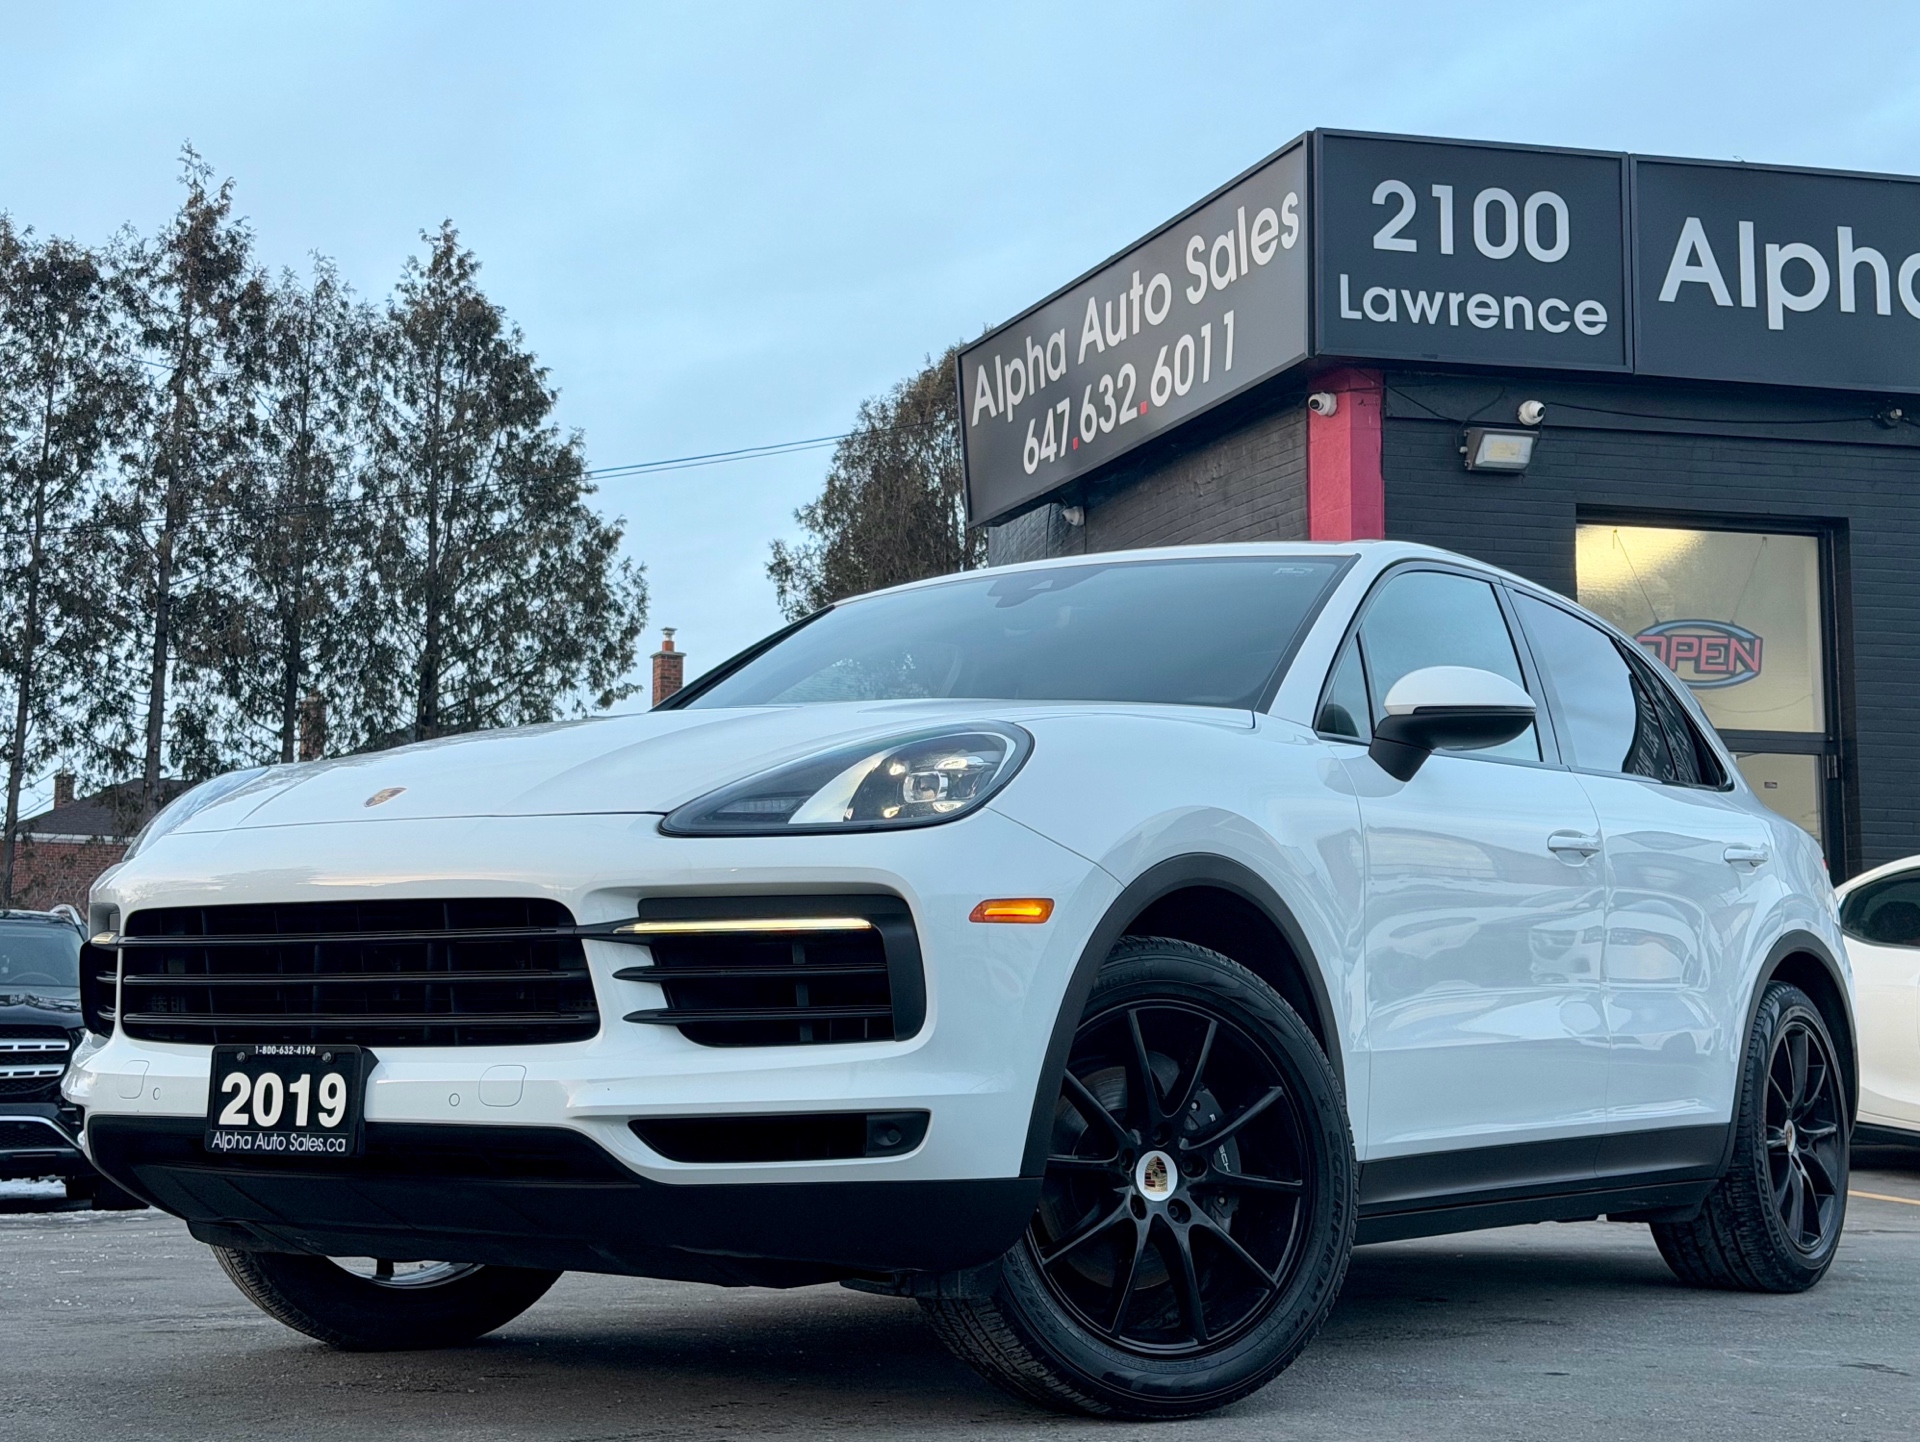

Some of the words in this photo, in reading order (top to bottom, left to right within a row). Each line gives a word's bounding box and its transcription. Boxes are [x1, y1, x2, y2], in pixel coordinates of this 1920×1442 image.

[1372, 179, 1570, 263] 2100
[971, 328, 1067, 427] Alpha
[1077, 270, 1172, 365] Auto
[1185, 191, 1299, 305] Sales
[1339, 273, 1608, 336] Lawrence
[1023, 309, 1235, 475] 647.632.6011
[255, 1045, 316, 1055] 1-800-632-4194
[218, 1071, 347, 1128] 2019
[211, 1131, 252, 1152] Alpha
[253, 1132, 287, 1151] Auto
[289, 1132, 347, 1153] Sales.ca
